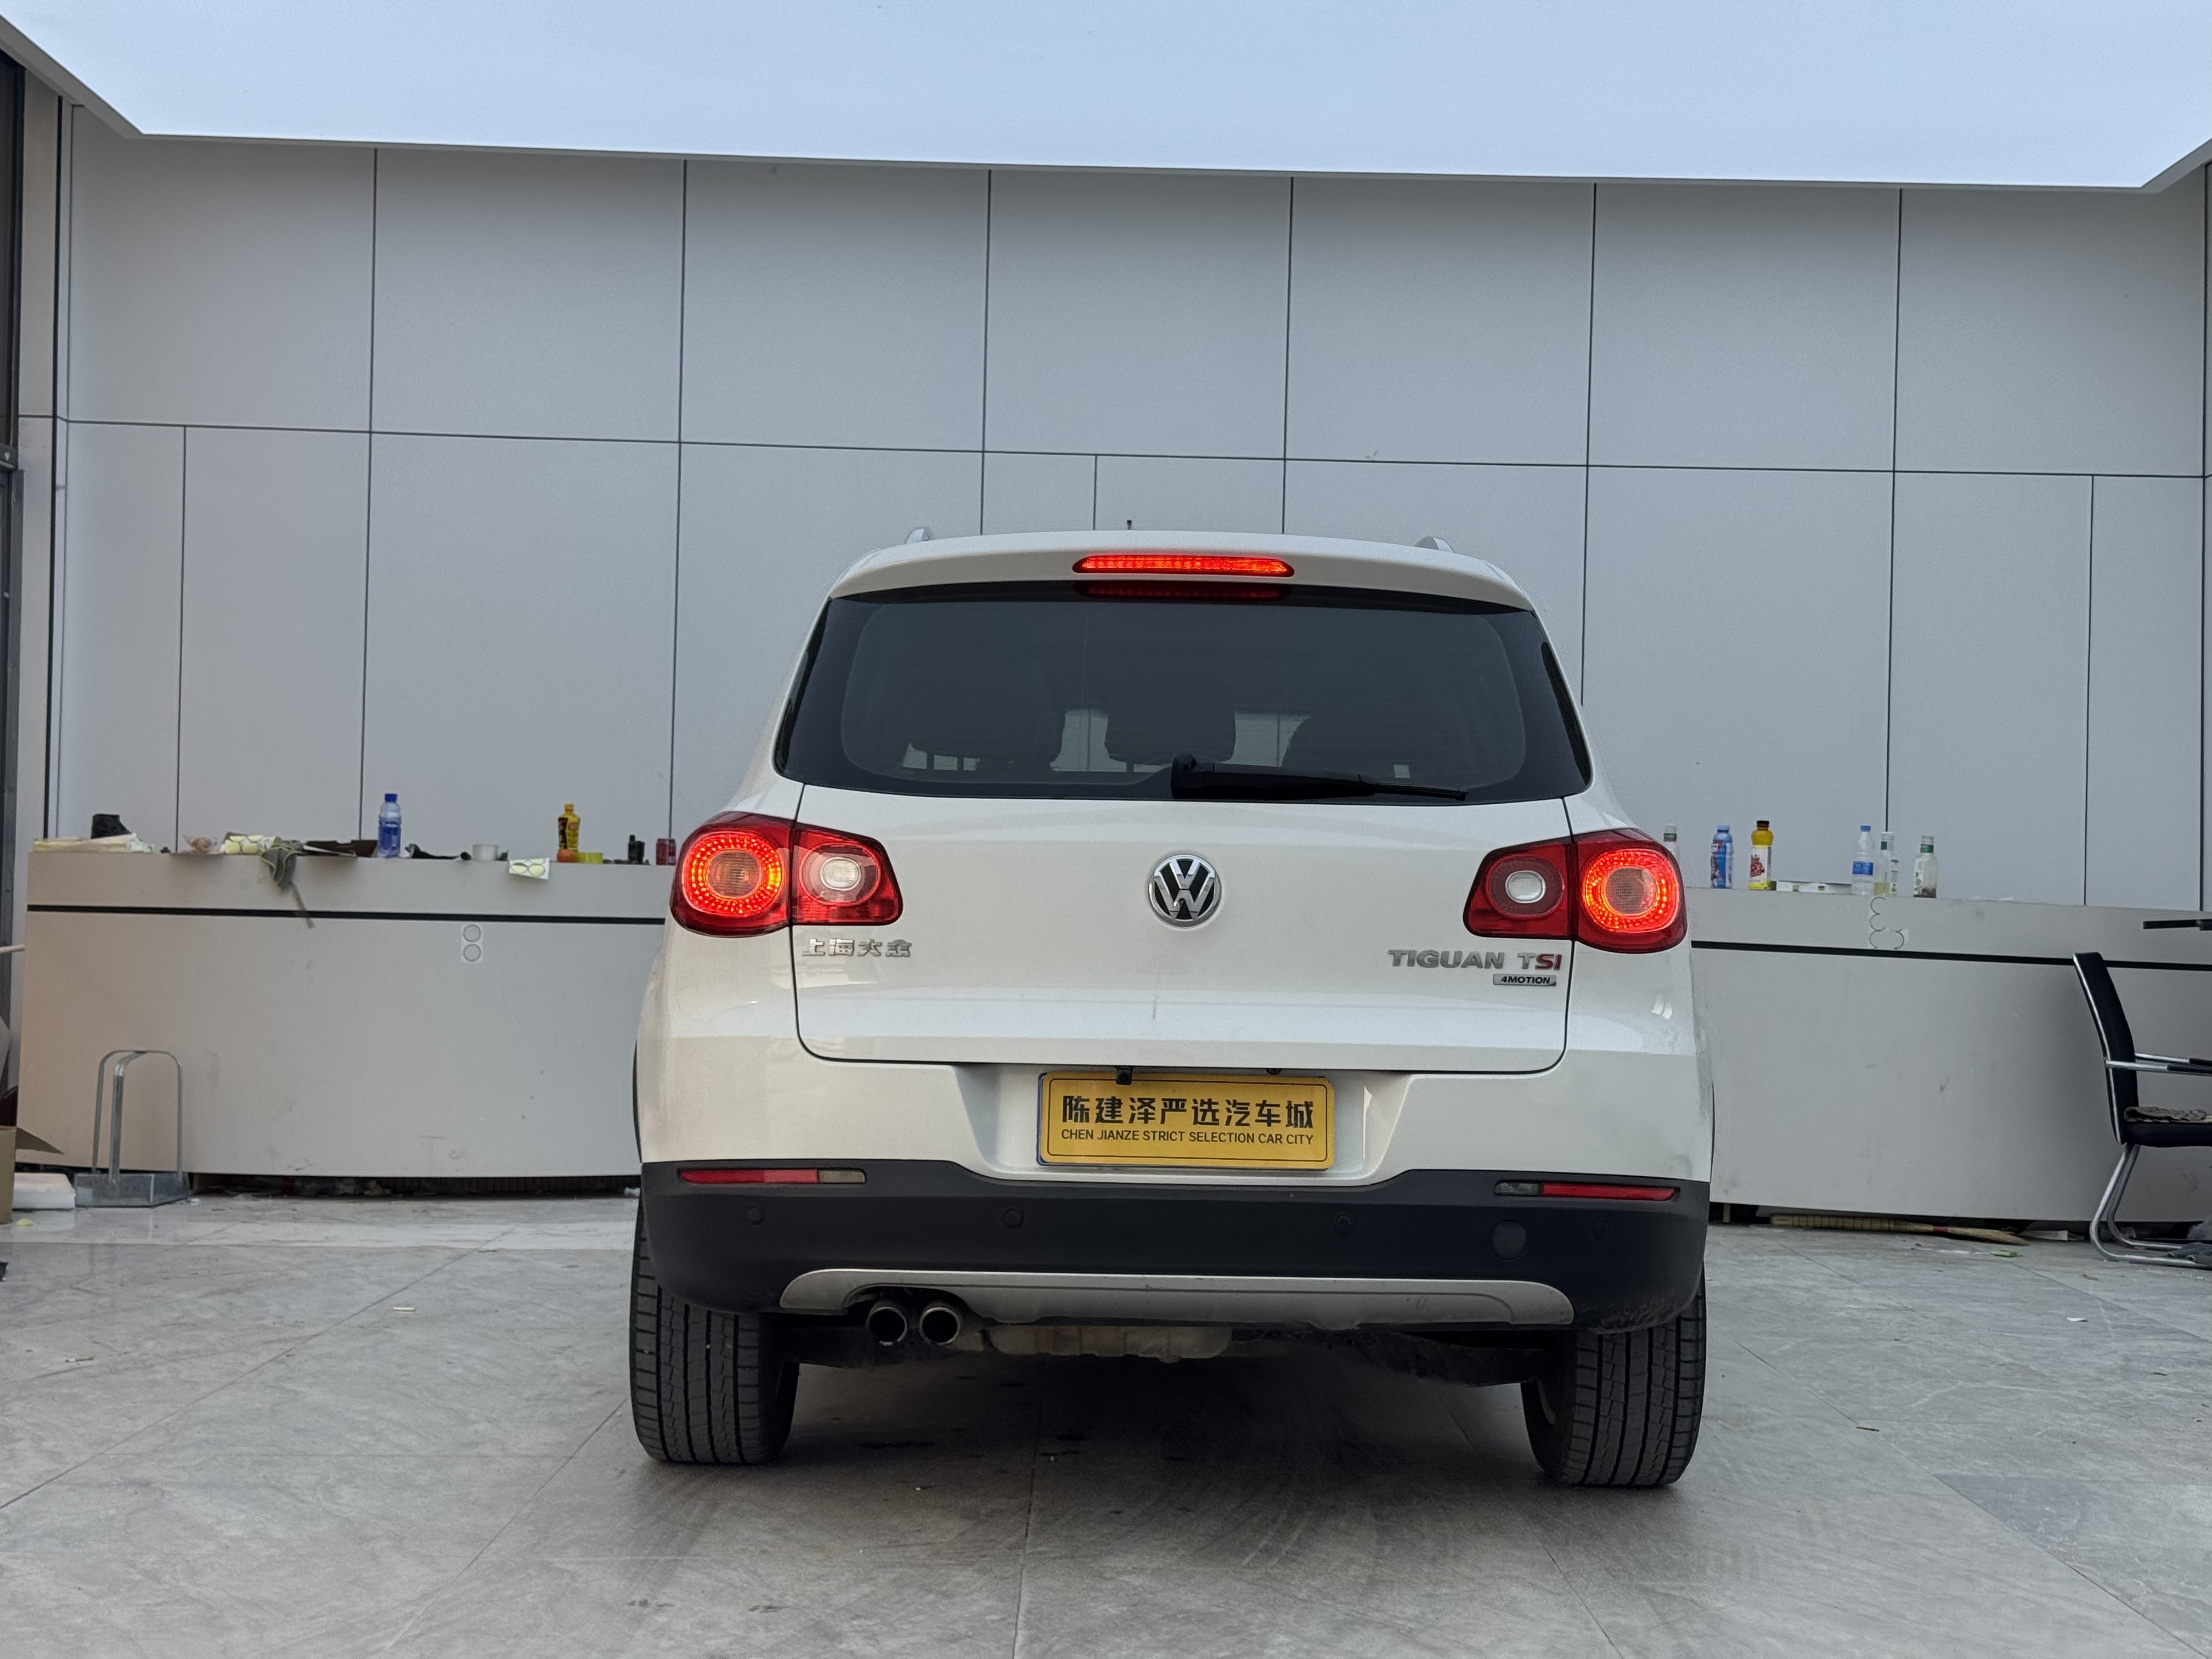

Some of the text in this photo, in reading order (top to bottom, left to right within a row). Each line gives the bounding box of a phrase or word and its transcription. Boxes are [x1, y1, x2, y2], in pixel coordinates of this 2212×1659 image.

[802, 938, 912, 957] 上海大众
[1388, 950, 1562, 970] TIGUAN TSI
[1500, 975, 1550, 984] 4MOTION
[1062, 1095, 1314, 1128] 陈建泽严选汽车城
[1061, 1128, 1314, 1145] CHEN JIANZE STRICT SELECTION CAR CITY
